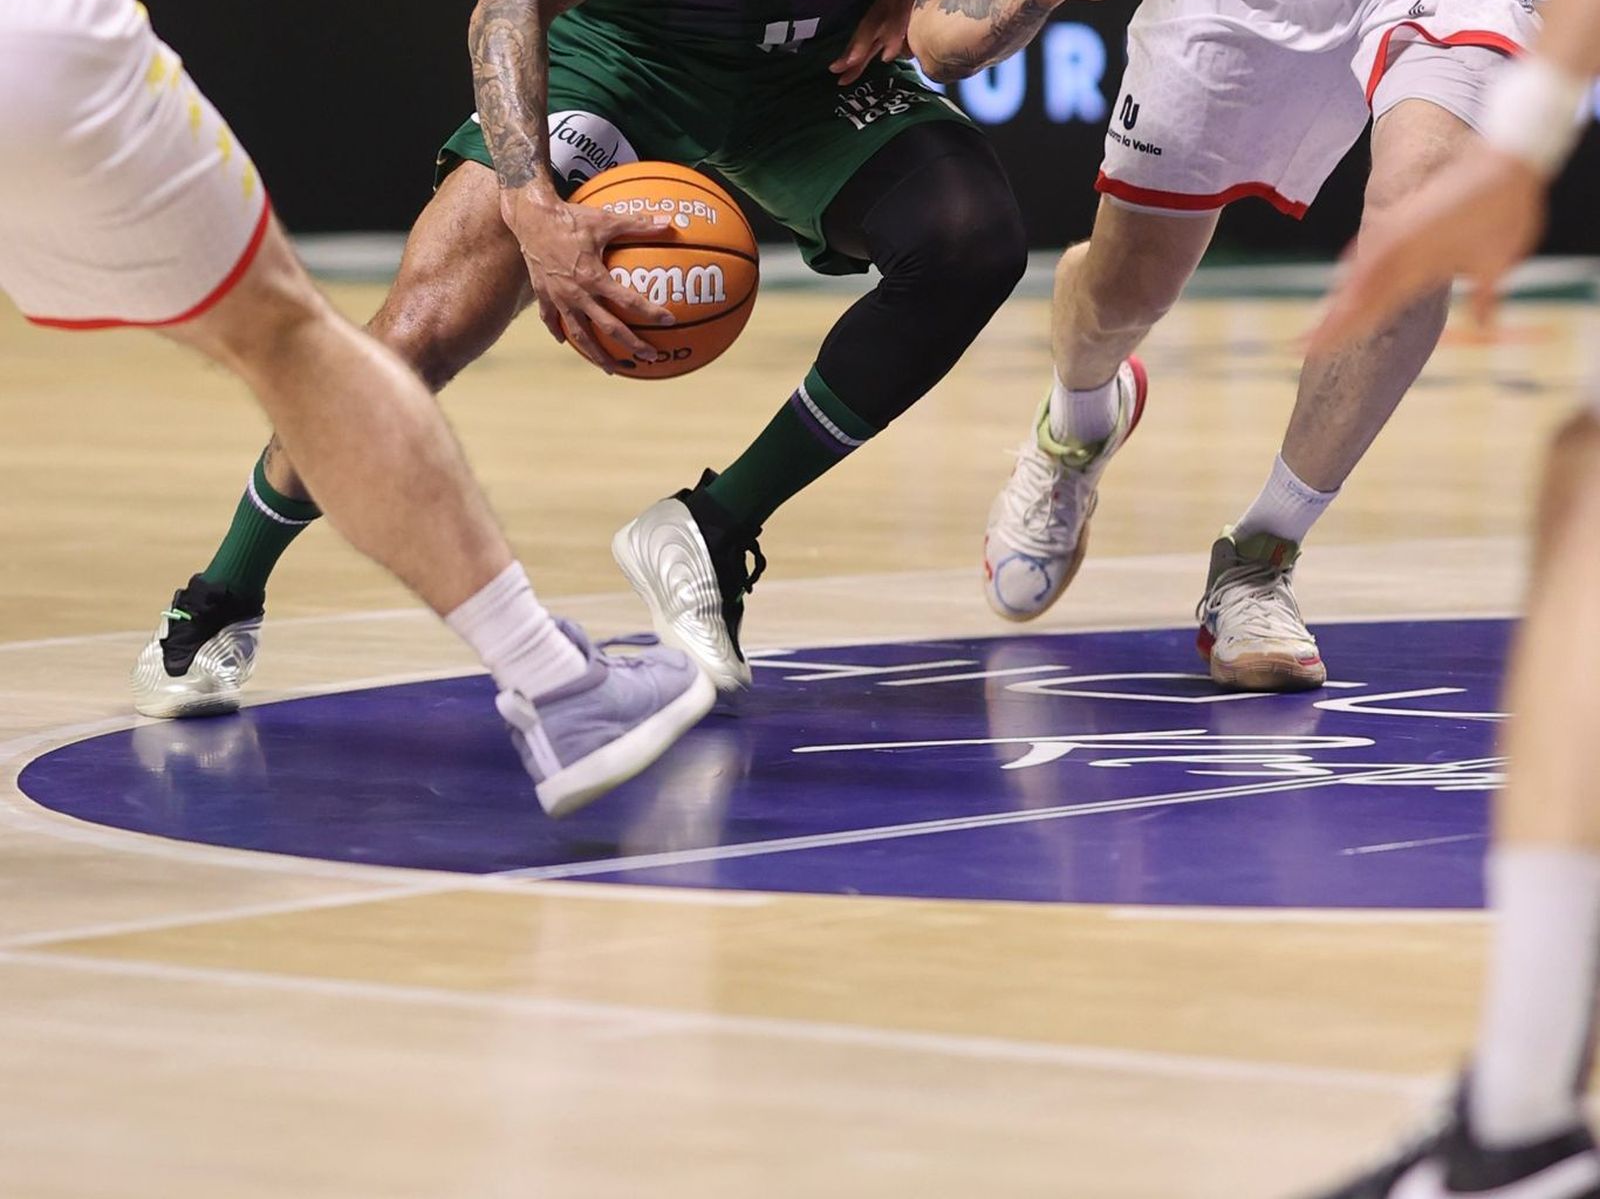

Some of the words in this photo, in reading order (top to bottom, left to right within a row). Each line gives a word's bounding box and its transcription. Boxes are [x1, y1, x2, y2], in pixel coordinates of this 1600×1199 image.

[549, 113, 618, 170] famade
[1122, 135, 1131, 147] la
[1132, 139, 1162, 156] Vella
[603, 197, 675, 214] ende
